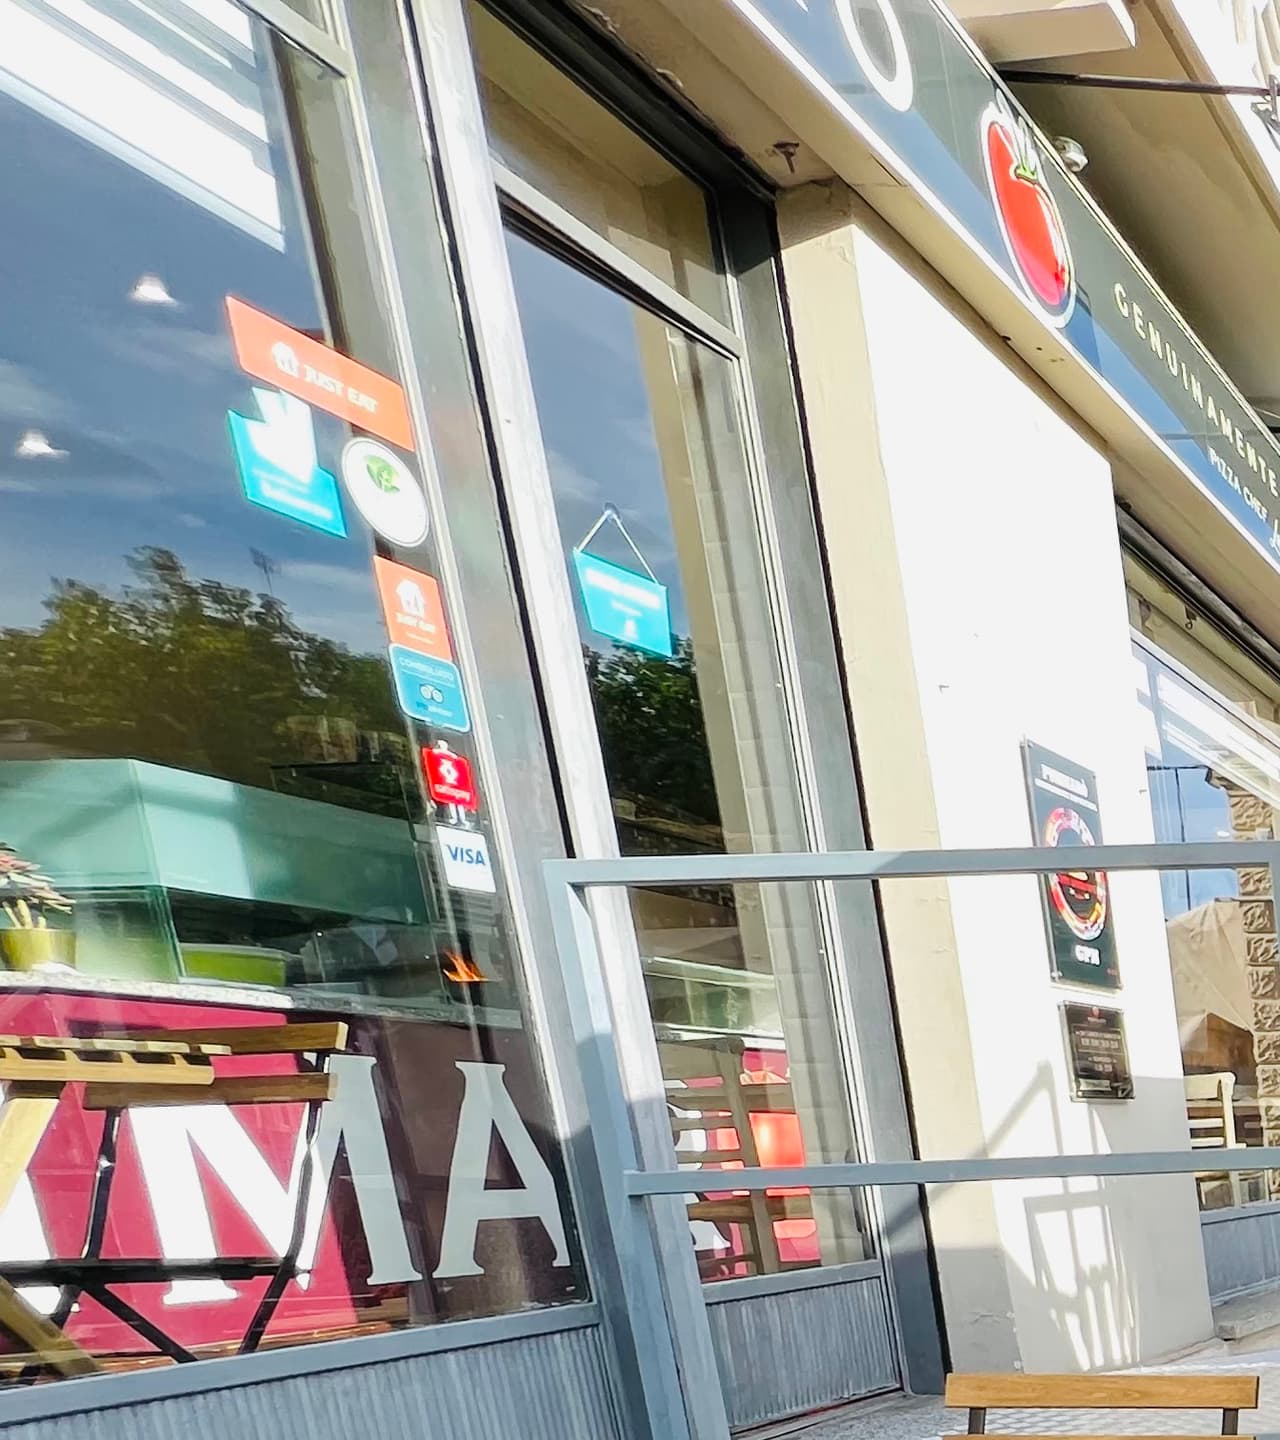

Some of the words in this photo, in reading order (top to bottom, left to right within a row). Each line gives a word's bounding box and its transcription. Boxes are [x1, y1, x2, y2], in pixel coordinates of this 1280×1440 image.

[303, 364, 345, 396] JUST
[1113, 282, 1279, 497] GENUINAMENTE
[1208, 446, 1242, 494] PIZZA
[1243, 486, 1268, 523] CHEF
[447, 844, 487, 866] VISA
